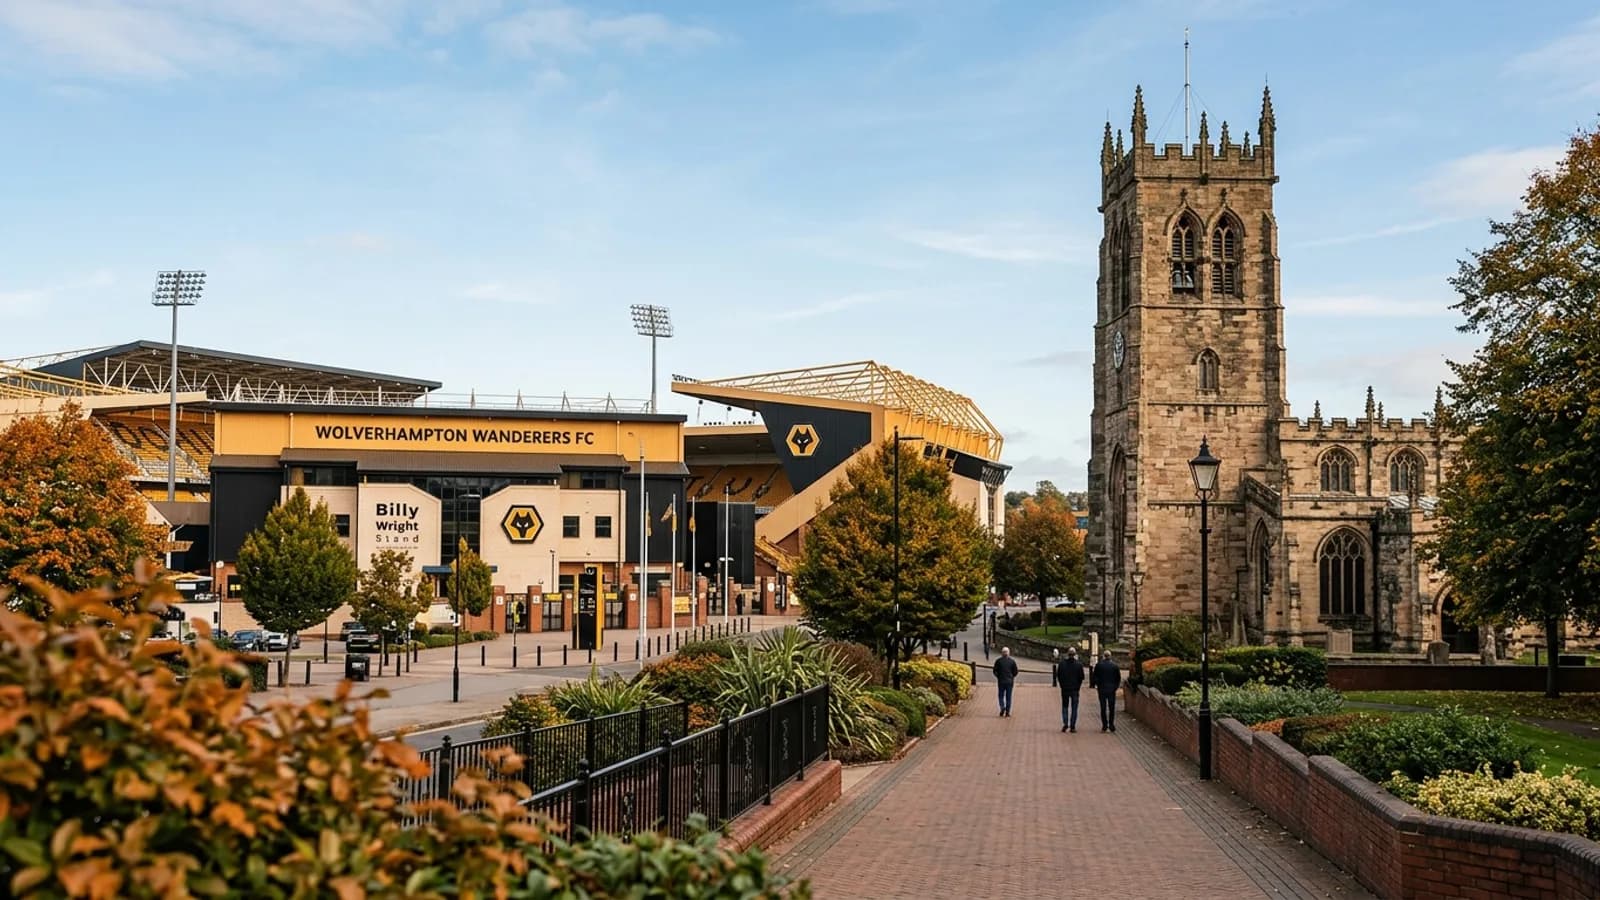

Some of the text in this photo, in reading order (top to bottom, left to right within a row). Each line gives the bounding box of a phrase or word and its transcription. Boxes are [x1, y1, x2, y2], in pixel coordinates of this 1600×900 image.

[315, 425, 595, 445] WOLVERHAMPTON WANDERERS FC
[376, 502, 419, 520] Billy
[375, 520, 419, 533] Wright
